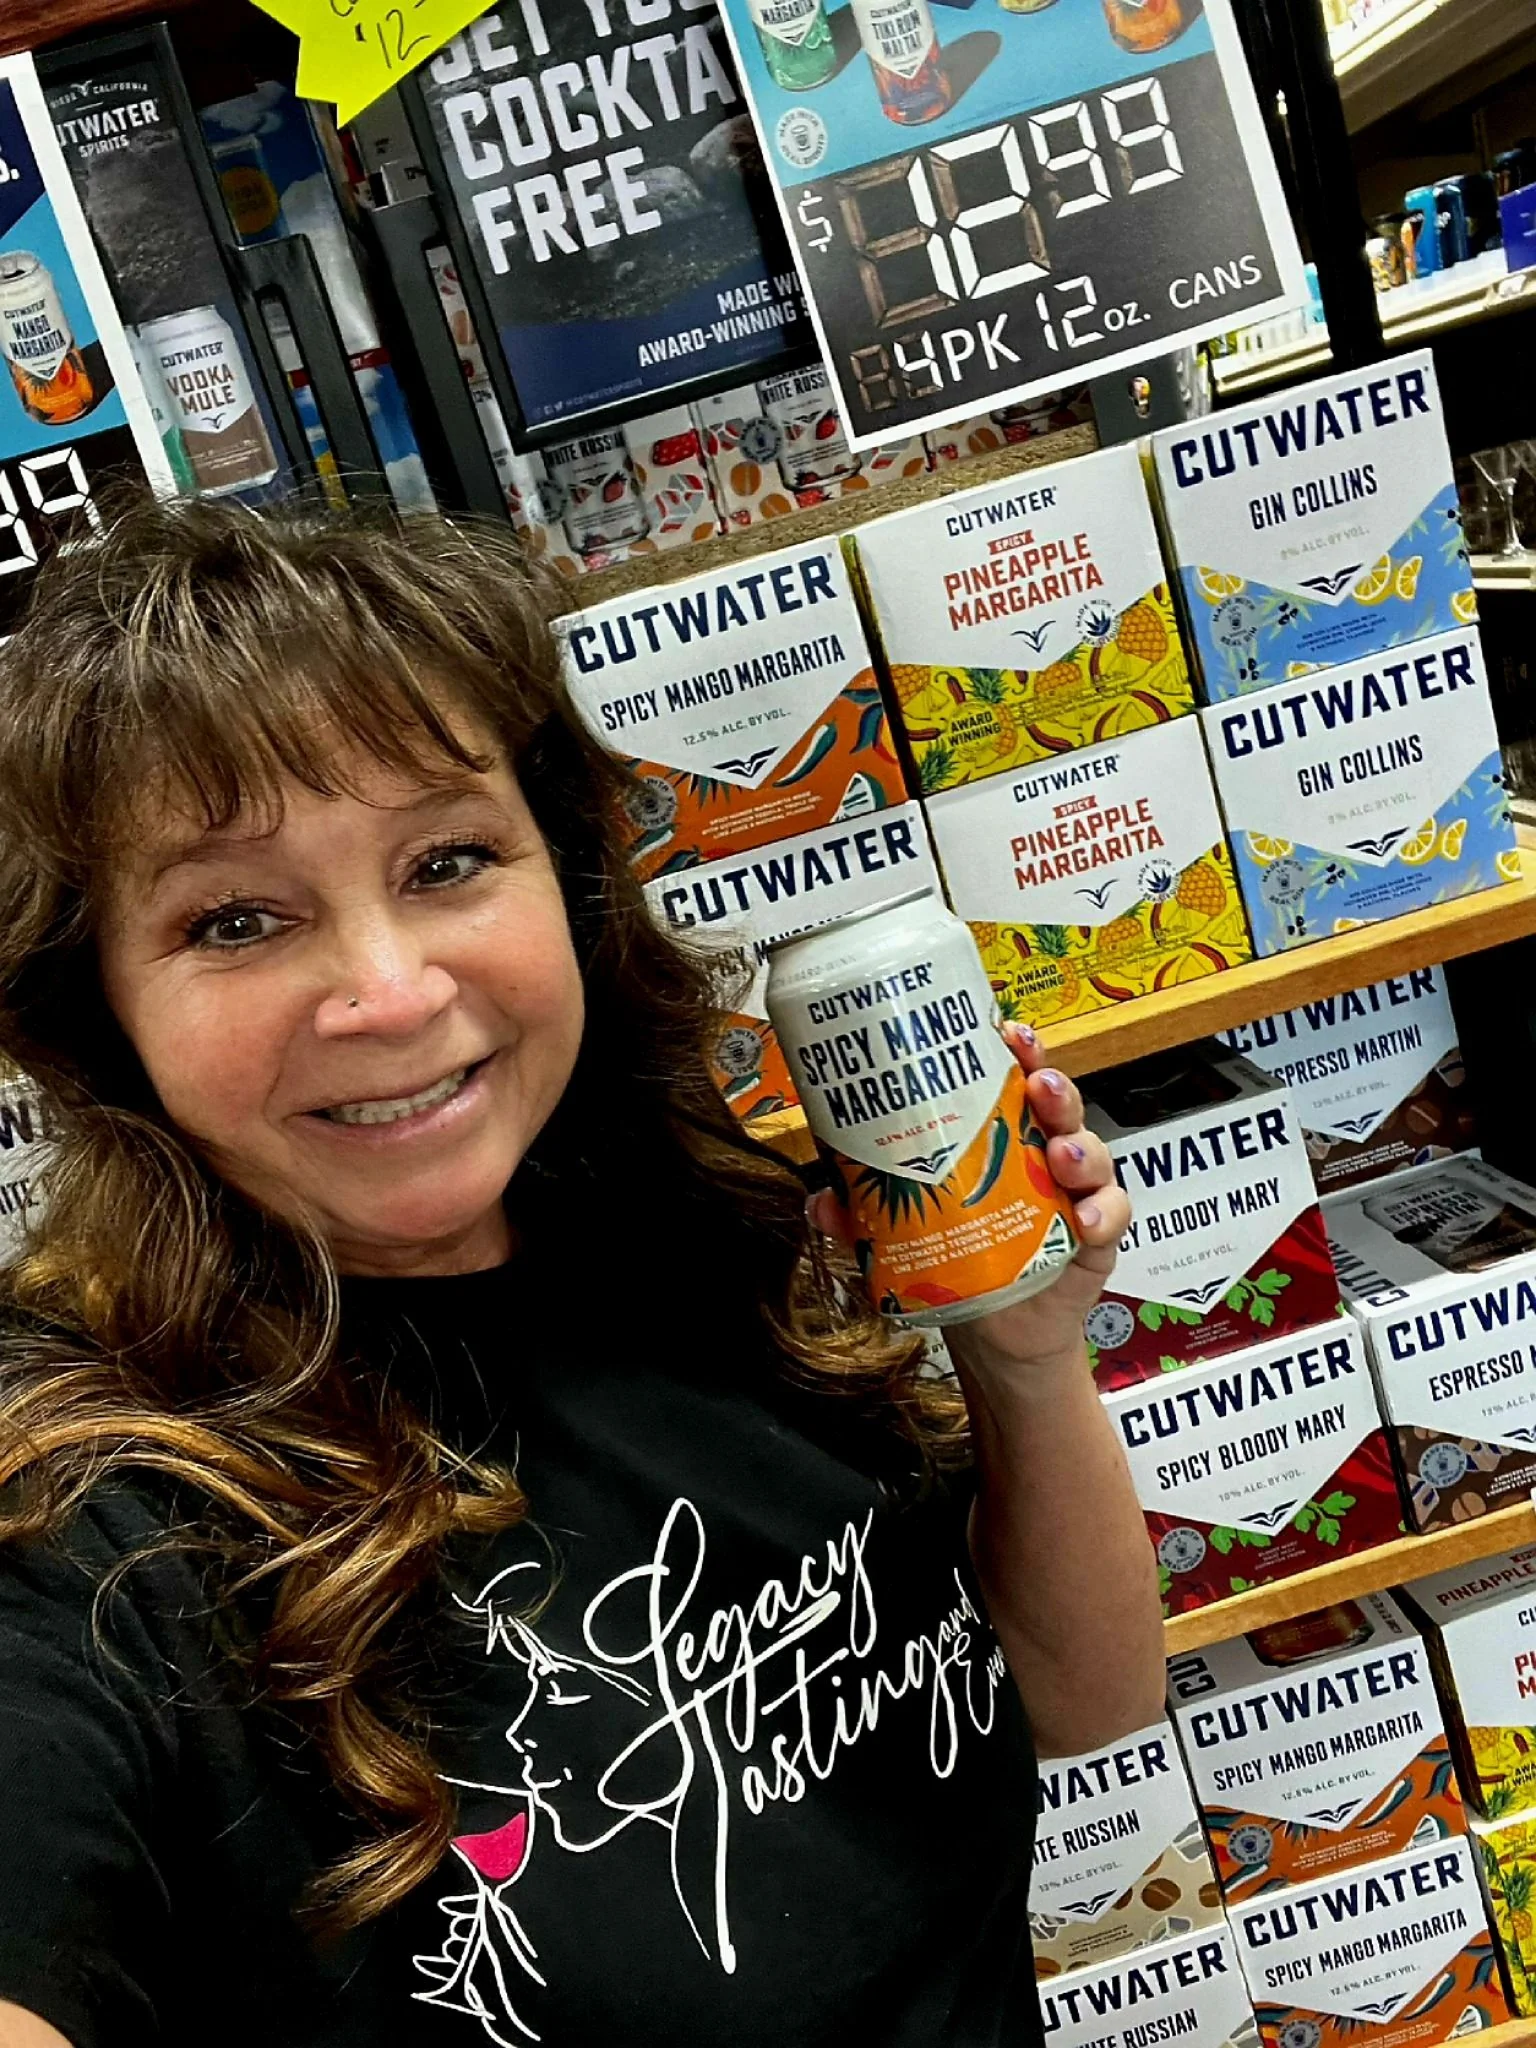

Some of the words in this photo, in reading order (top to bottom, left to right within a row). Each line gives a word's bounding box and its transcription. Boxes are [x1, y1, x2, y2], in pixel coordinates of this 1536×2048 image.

[55, 99, 160, 147] UTWATER
[443, 25, 737, 180] COCKTA
[78, 134, 130, 157] SPIRITS
[472, 146, 662, 274] FREE
[797, 190, 834, 252] $
[717, 280, 771, 315] MADE
[1168, 254, 1264, 310] CANS
[9, 329, 66, 360] MARGARITA
[12, 315, 51, 338] MANGO
[160, 341, 223, 368] CUTWATER
[638, 303, 797, 367] AWARD-WINNING
[166, 363, 235, 396] VODKA
[179, 386, 236, 416] MULE
[1170, 368, 1432, 489] CUTWATER
[946, 487, 1057, 537] CUTWATER
[1249, 491, 1287, 530] GIN
[1292, 464, 1378, 518] COLLINS
[943, 533, 1092, 601] PINEAPPLE
[947, 562, 1106, 632] MARGARITA
[569, 555, 838, 675] CUTWATER
[600, 690, 660, 732] SPICY
[664, 667, 735, 713] MANGO
[734, 634, 846, 692] MARGARITA
[1221, 644, 1477, 759] CUTWATER
[682, 727, 719, 748] 12.5%
[721, 720, 747, 736] ALC.
[748, 714, 765, 729] BY
[764, 709, 791, 724] VOL.
[949, 723, 1002, 749] WINNING
[950, 711, 993, 734] AWARD
[1012, 756, 1119, 803] CUTWATER
[1297, 761, 1335, 797] GIN
[1340, 734, 1424, 786] COLLINS
[1010, 797, 1154, 861] PINEAPPLE
[1060, 799, 1090, 816] SPICY
[663, 819, 919, 929] CUTWATER
[1014, 825, 1165, 890] MARGARITA
[807, 963, 933, 1025] CUTWATER
[1013, 973, 1066, 999] WINNING
[1016, 963, 1058, 986] AWARD
[798, 1026, 876, 1087] SPICY
[880, 989, 979, 1061] MANGO
[1354, 1023, 1423, 1066] MARTINI
[823, 1040, 987, 1129] MARGARITA
[1114, 1107, 1290, 1194] TWATER
[1147, 1197, 1222, 1243] BLOODY
[1226, 1177, 1281, 1217] MARY
[1173, 1254, 1197, 1270] ALC.
[1199, 1248, 1213, 1263] BY
[1387, 1280, 1536, 1361] CUTWA
[1120, 1338, 1356, 1449] CUTWATER
[1429, 1349, 1524, 1402] ESPRESSO
[1156, 1451, 1212, 1491] SPICY
[1218, 1424, 1290, 1470] BLOODY
[1295, 1404, 1347, 1444] MARY
[1243, 1481, 1267, 1496] ALC.
[1268, 1476, 1282, 1489] BY
[1282, 1469, 1306, 1484] VOL.
[1436, 1563, 1536, 1606] PINEAPPLE
[1190, 1653, 1420, 1749] CUTWATER
[1038, 1739, 1170, 1815] WATER
[1213, 1757, 1264, 1791] SPICY
[1269, 1739, 1328, 1775] MANGO
[1329, 1710, 1424, 1757] MARGARITA
[1315, 1779, 1338, 1794] ALC.
[1062, 1809, 1141, 1849] RUSSIAN
[1062, 1872, 1085, 1886] ALC.
[1086, 1866, 1099, 1878] BY
[1098, 1860, 1124, 1875] VOL.
[1243, 1852, 1464, 1949] CUTWATER
[1264, 1956, 1313, 1988] SPICY
[1318, 1938, 1375, 1973] MANGO
[1376, 1908, 1468, 1954] MARGARITA
[1043, 1941, 1229, 2033] UTWATER
[1362, 1974, 1384, 1989] ALC.
[1122, 2008, 1199, 2048] RUSSIAN
